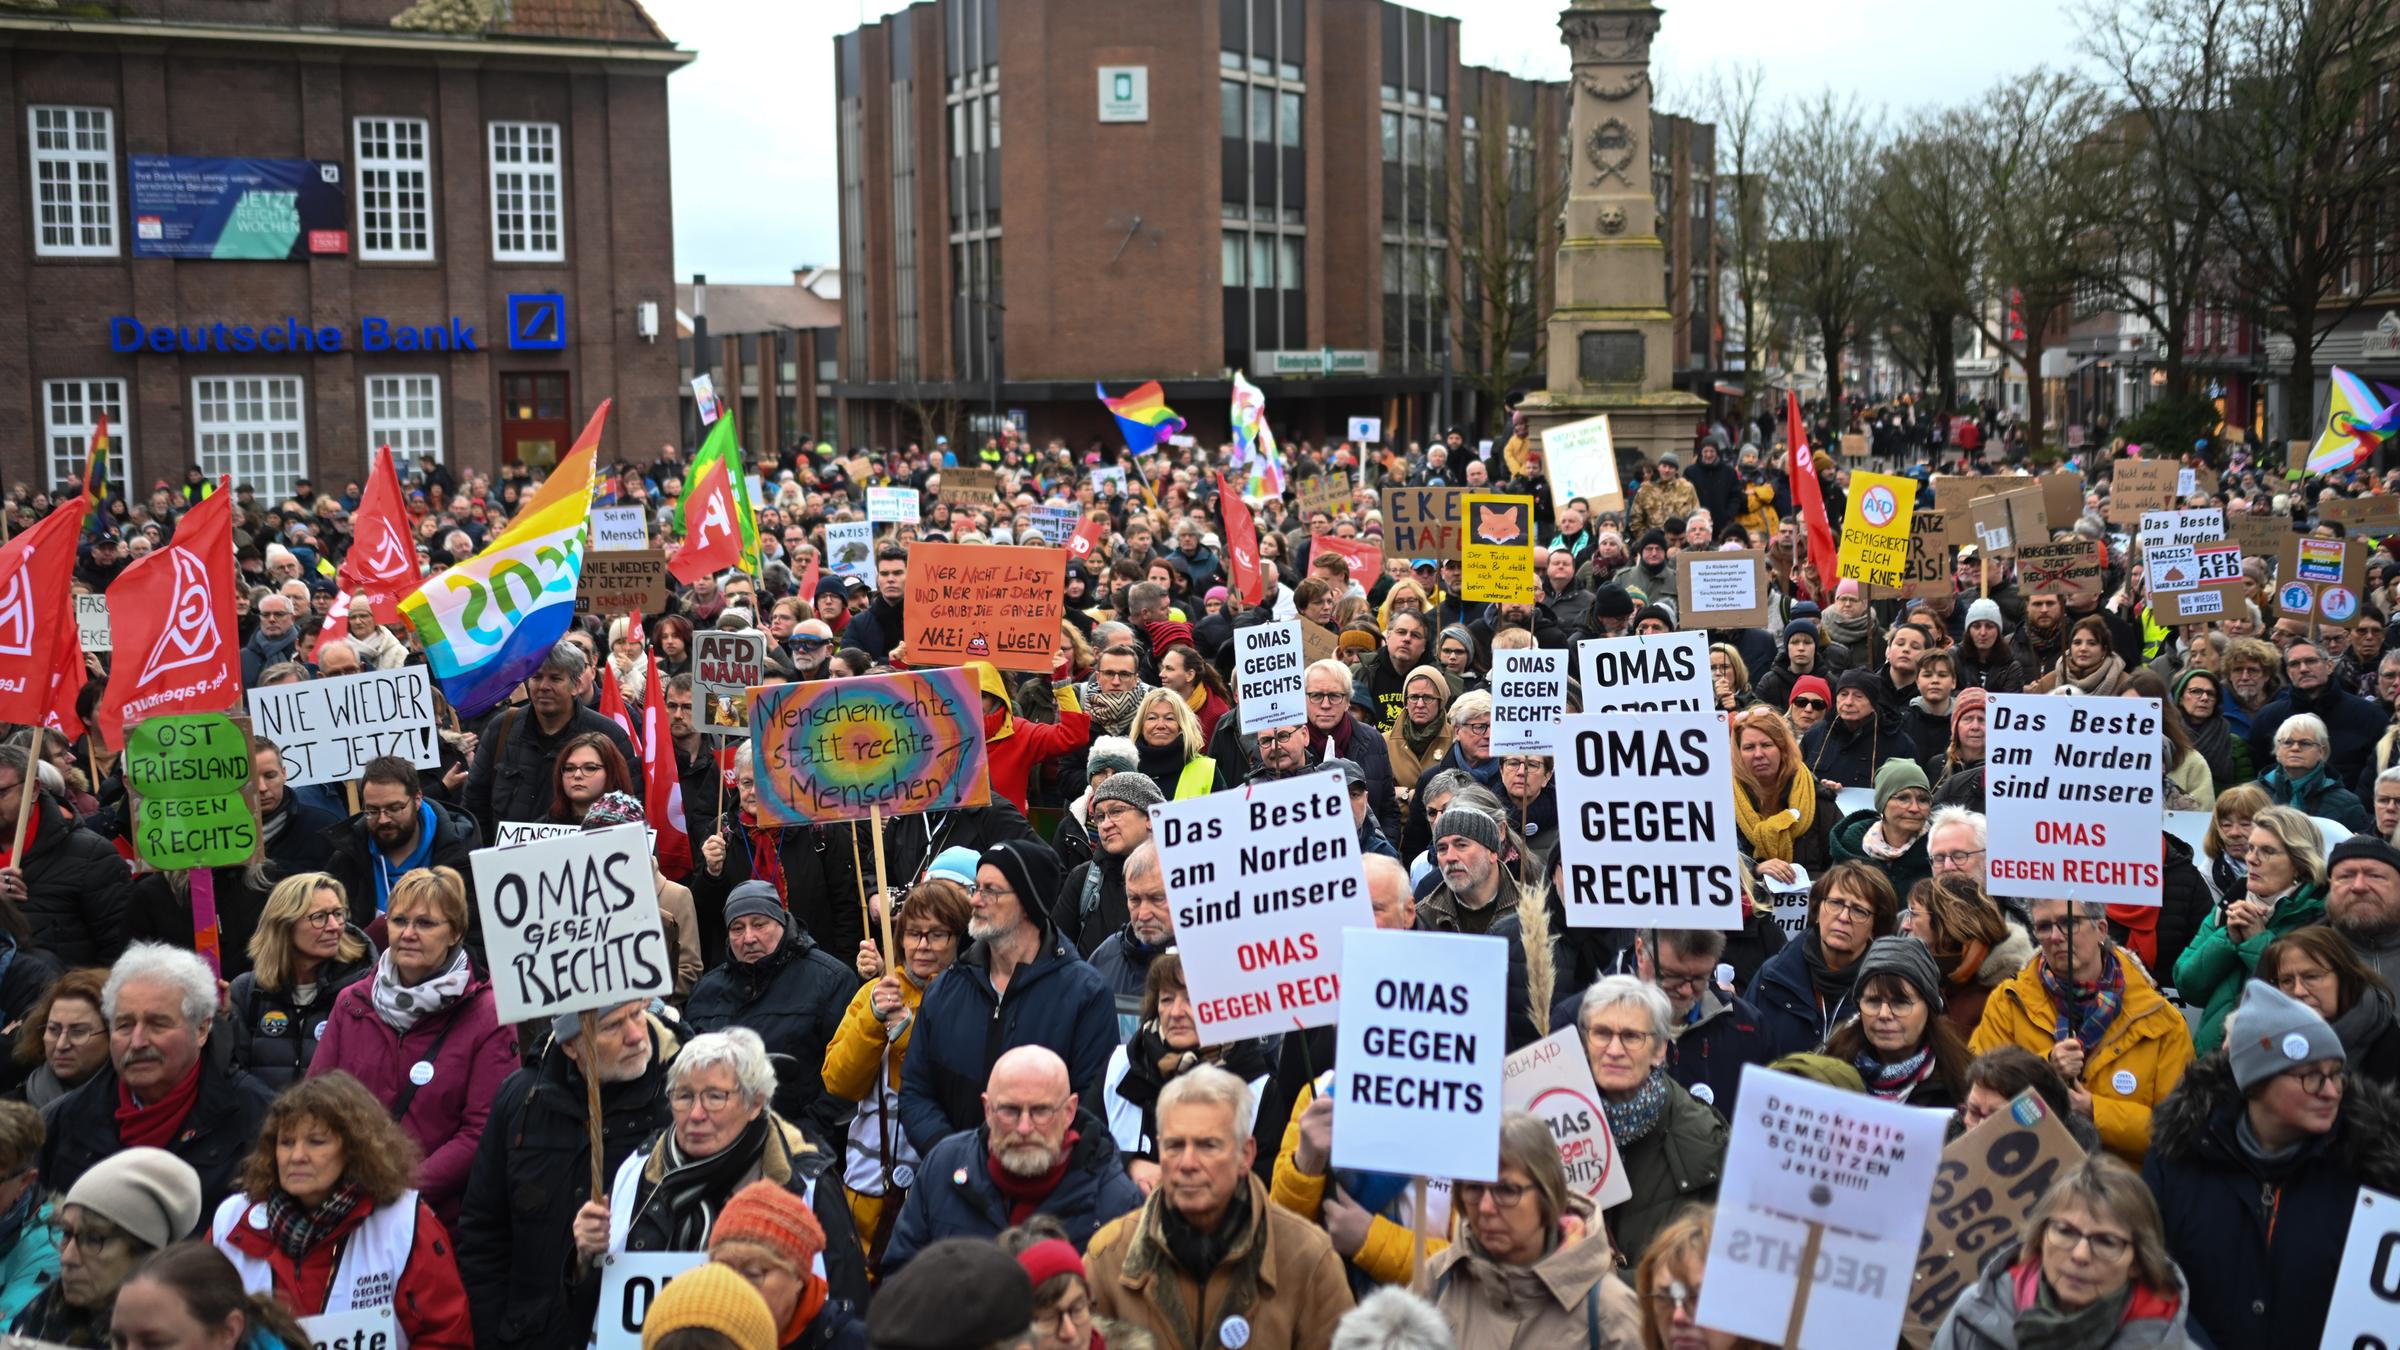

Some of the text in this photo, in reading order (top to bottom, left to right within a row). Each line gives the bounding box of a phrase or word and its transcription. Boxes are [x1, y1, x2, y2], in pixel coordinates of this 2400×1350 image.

[238, 190, 299, 208] JETZT
[237, 220, 301, 234] WOCHEN
[110, 316, 478, 353] Deutsche Bank
[604, 511, 636, 522] Sei ein
[2144, 515, 2221, 530] Das Beste
[600, 528, 646, 542] Mensch
[828, 527, 870, 540] NAZIS?
[1844, 528, 1909, 553] REMIGRIERT
[2144, 531, 2221, 547] am Norden
[1860, 549, 1891, 566] EUCH
[2042, 557, 2075, 569] STATT
[2151, 547, 2193, 561] NAZIS?
[2198, 551, 2240, 567] FCK
[586, 560, 662, 575] NIE WIEDER
[924, 563, 957, 584] WER
[1842, 563, 1904, 589] INS KNIE!
[2199, 564, 2241, 580] AFD
[578, 575, 654, 590] ST JETZT!
[914, 587, 939, 604] UND
[1009, 586, 1053, 602] DENKT
[930, 603, 972, 619] GLAUBT
[1000, 603, 1057, 618] GANZEN
[2181, 605, 2194, 614] IST
[699, 637, 755, 663] AFD
[996, 626, 1052, 650] LÜGEN
[1246, 628, 1292, 650] OMAS
[1244, 651, 1297, 675] GEGEN
[1506, 656, 1556, 673] OMAS
[1595, 645, 1696, 688] OMAS
[1242, 674, 1303, 700] RECHTS
[1500, 680, 1559, 698] GEGEN
[260, 673, 429, 738] NIE WIEDER
[755, 680, 957, 732] Menschenrechte
[1993, 706, 2156, 736] Das Beste
[157, 721, 221, 748] OST
[280, 725, 432, 782] ST JETZT!
[773, 727, 934, 770] statt rechte
[1575, 727, 1711, 778] OMAS
[1991, 743, 2153, 771] am Norden
[1991, 774, 2154, 805] sind unsere
[146, 798, 228, 821] GEGEN
[1164, 792, 1343, 848] Das Beste
[1580, 800, 1716, 843] GEGEN
[146, 823, 254, 857] RECHTS
[2035, 820, 2107, 847] OMAS
[1169, 835, 1348, 890] am Norden
[1990, 858, 2160, 888] GEGEN RECHTS
[493, 851, 636, 928] OMAS
[1571, 863, 1734, 907] RECHTS
[1179, 876, 1358, 929] sind unsere
[523, 916, 613, 954] GEGEN
[1236, 932, 1319, 973] OMAS
[511, 929, 663, 1007] RECHTS
[1197, 990, 1273, 1025] GEGEN
[1375, 979, 1470, 1016] OMAS
[1362, 1025, 1477, 1066] GEGEN
[1351, 1072, 1485, 1115] RECHTS
[1766, 1094, 1906, 1143] Demokratie
[1760, 1113, 1907, 1163] GEMEINSAM
[1767, 1133, 1892, 1178] SCHÜTZEN
[352, 1282, 392, 1299] GEGEN
[356, 1272, 390, 1287] OMAS
[350, 1294, 391, 1311] RECHT
